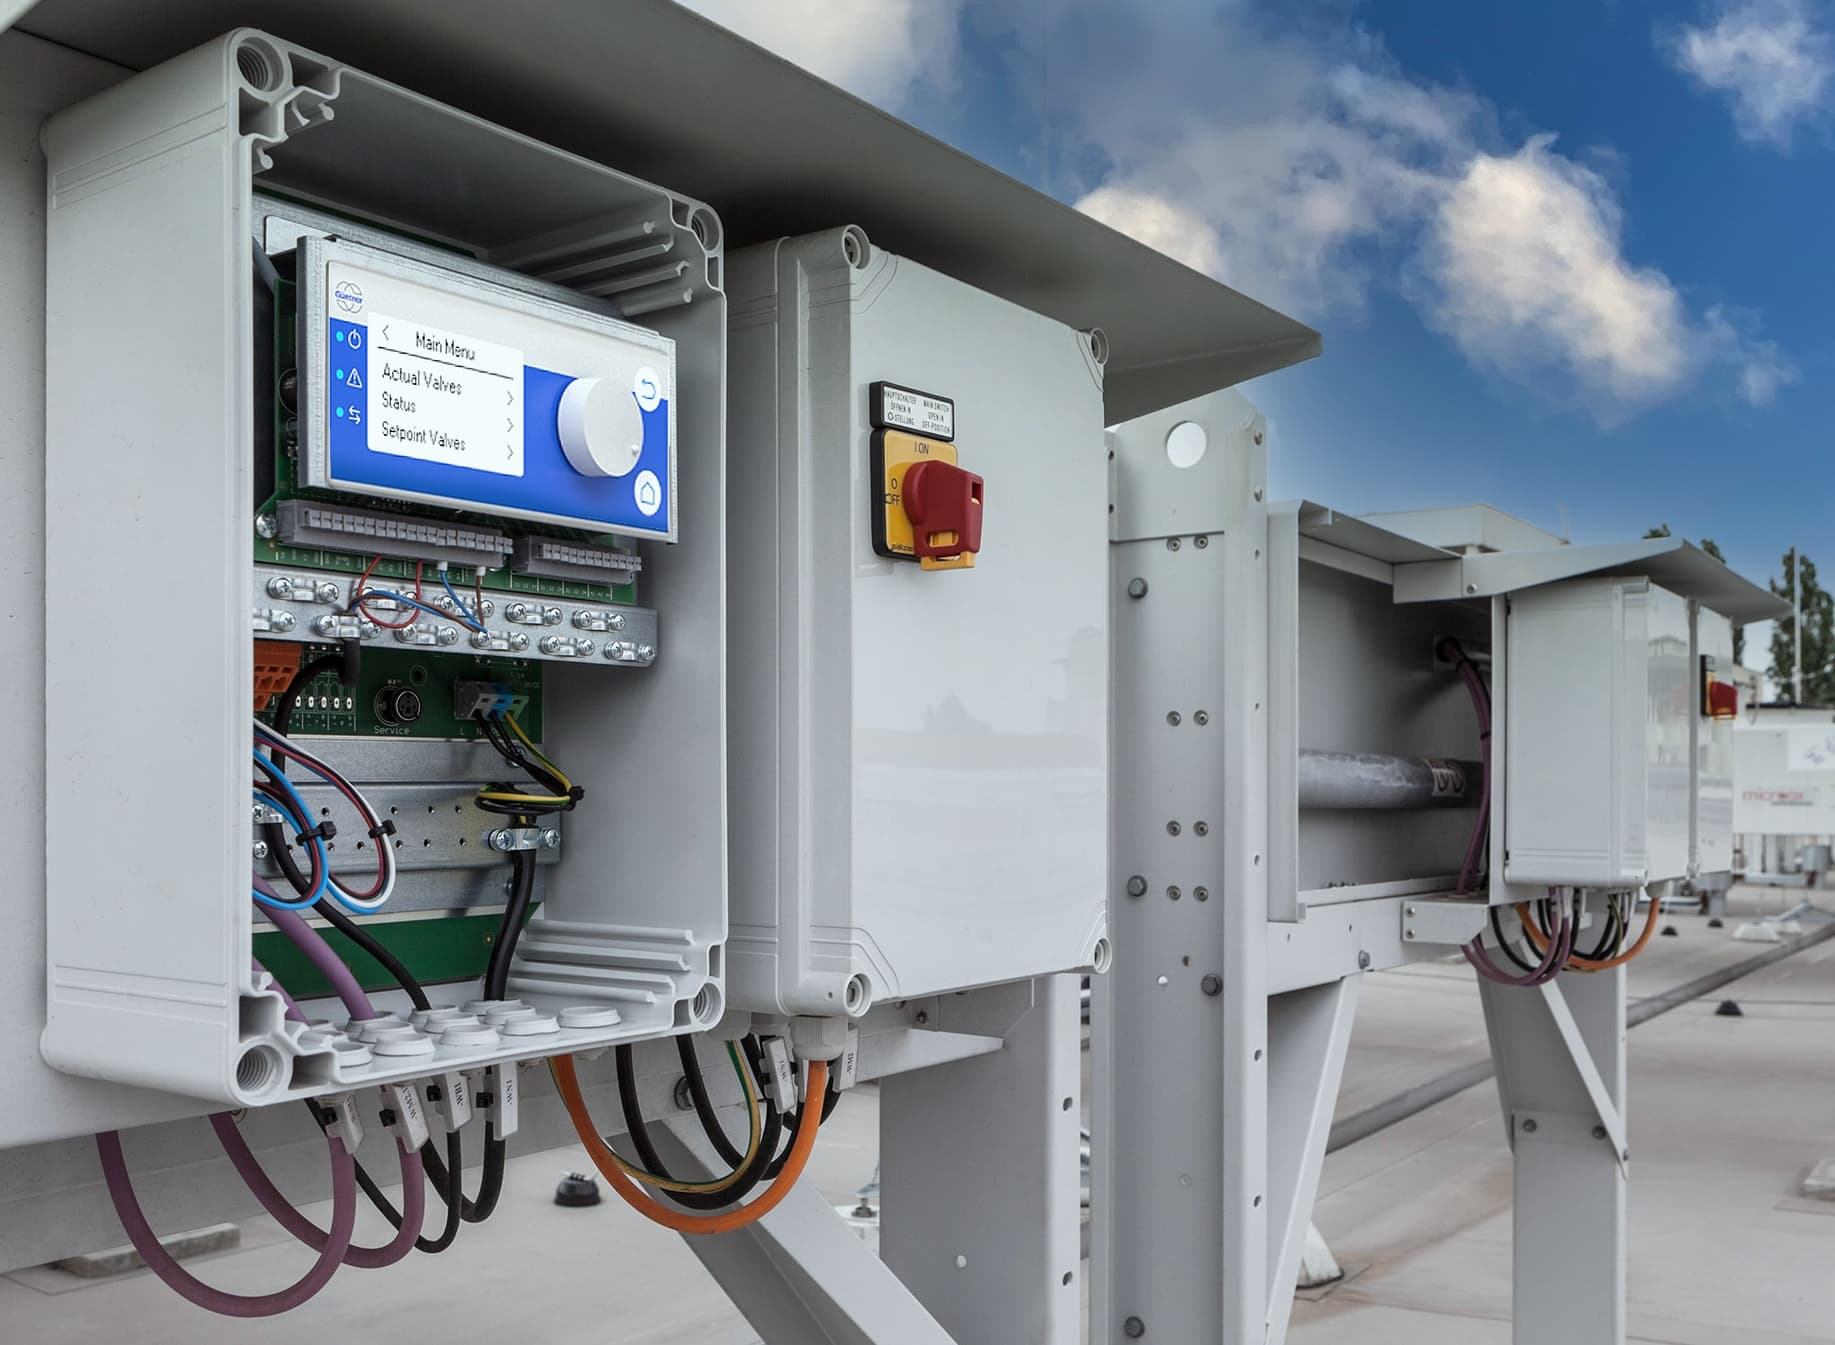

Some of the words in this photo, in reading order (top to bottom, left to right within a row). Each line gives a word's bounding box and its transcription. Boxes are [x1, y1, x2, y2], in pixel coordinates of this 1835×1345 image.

[415, 331, 442, 353] Main
[445, 338, 475, 360] Menu
[382, 362, 420, 386] Actual
[423, 371, 462, 395] Valves
[382, 391, 416, 413] Status
[382, 420, 426, 442] Setpoint
[429, 429, 465, 451] Valves
[919, 442, 929, 455] ON
[884, 493, 900, 506] OFF
[373, 726, 410, 735] Service
